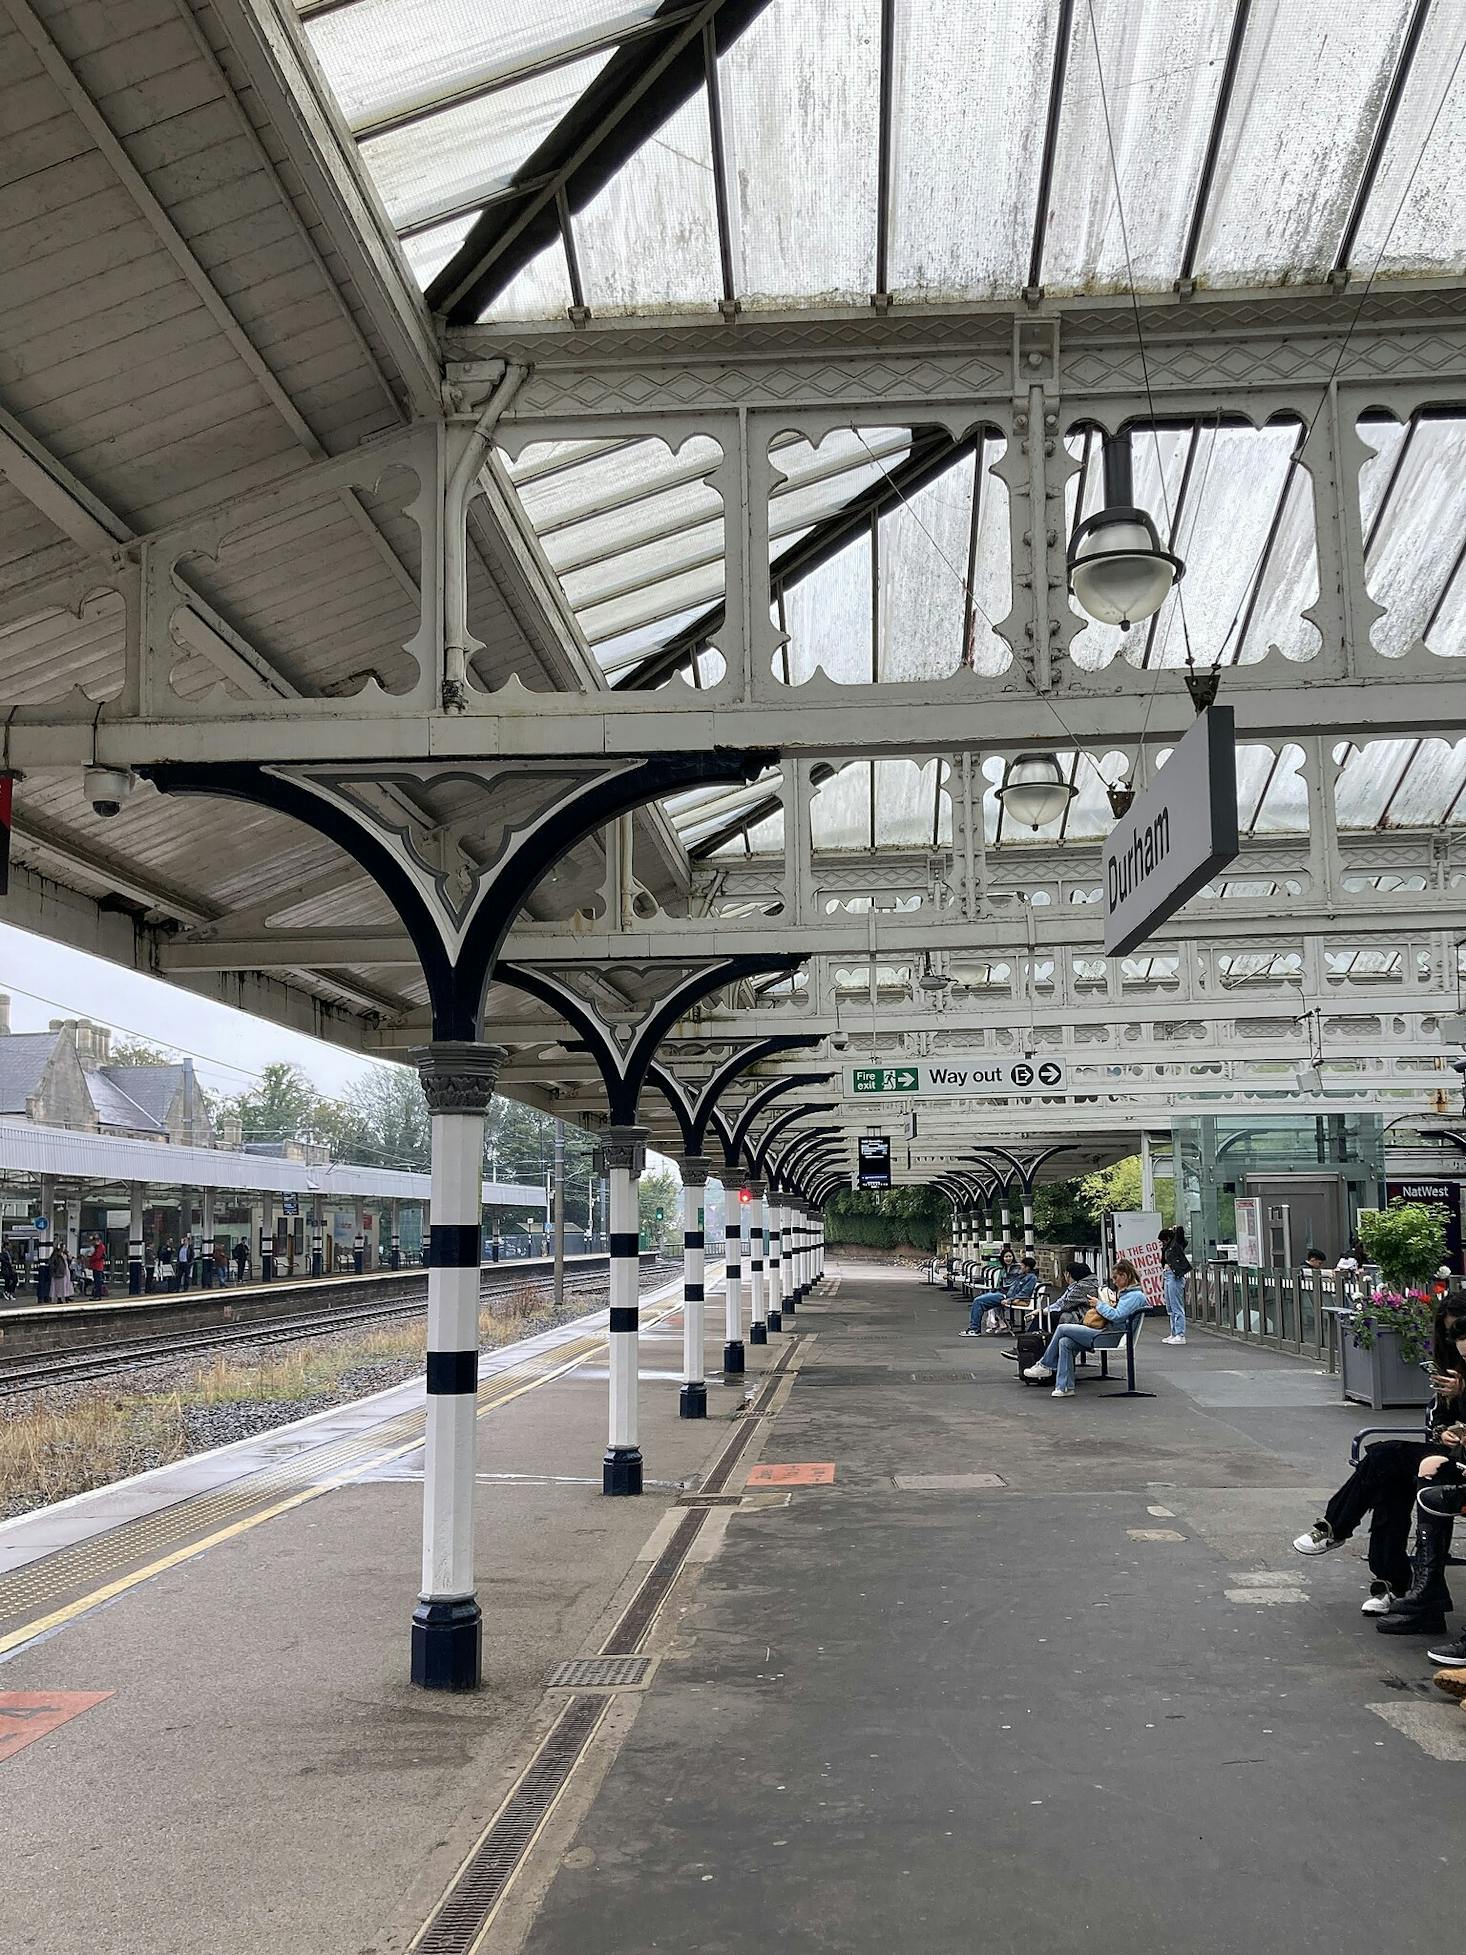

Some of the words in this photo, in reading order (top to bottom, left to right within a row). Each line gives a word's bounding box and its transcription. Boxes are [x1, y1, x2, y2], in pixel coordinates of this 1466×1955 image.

[1108, 806, 1170, 915] Durham
[856, 1071, 876, 1081] Fire
[929, 1068, 968, 1087] Way
[973, 1067, 1002, 1083] out
[856, 1081, 876, 1090] exit
[1402, 1186, 1449, 1197] NatWest
[1127, 1245, 1144, 1257] THE
